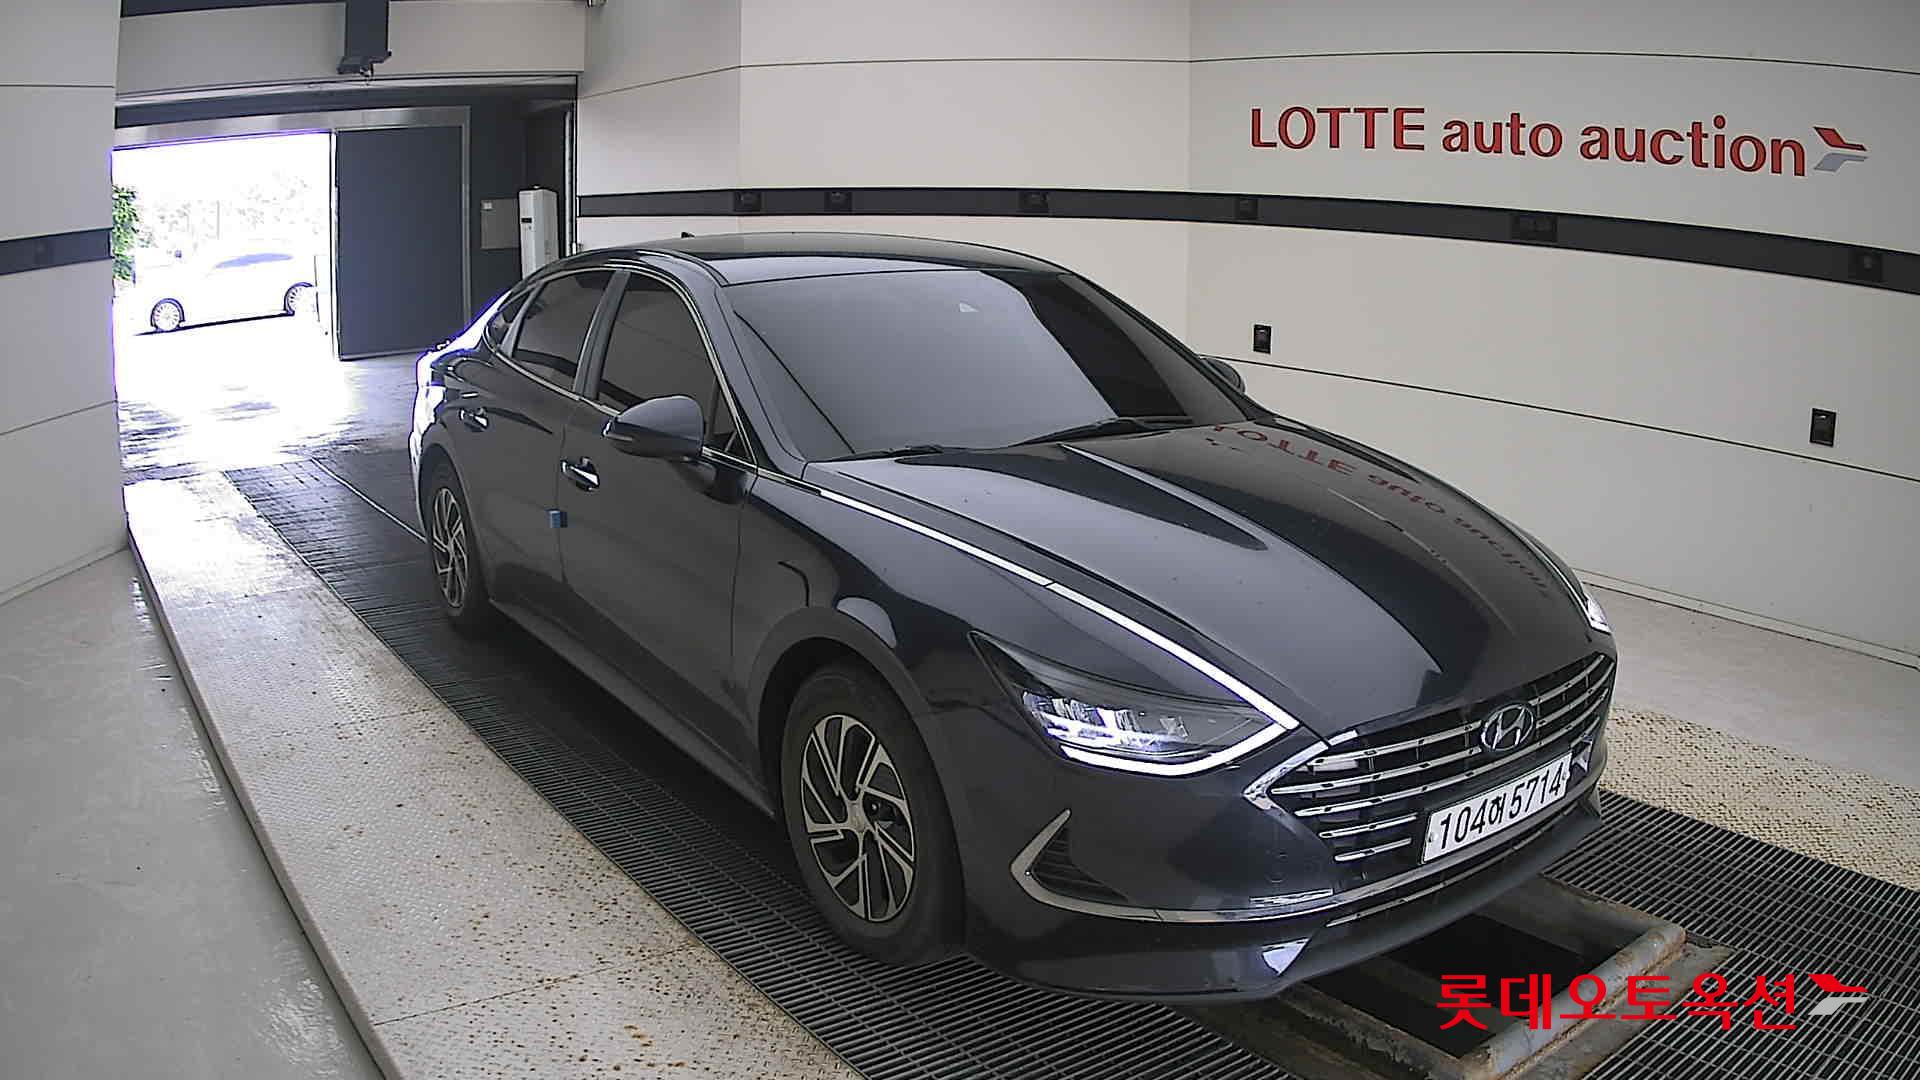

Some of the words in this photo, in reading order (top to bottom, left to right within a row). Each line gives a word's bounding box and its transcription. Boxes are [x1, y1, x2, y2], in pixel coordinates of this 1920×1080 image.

[1251, 107, 1425, 150] LOTTE
[1442, 112, 1563, 158] auto
[1580, 115, 1806, 176] auction
